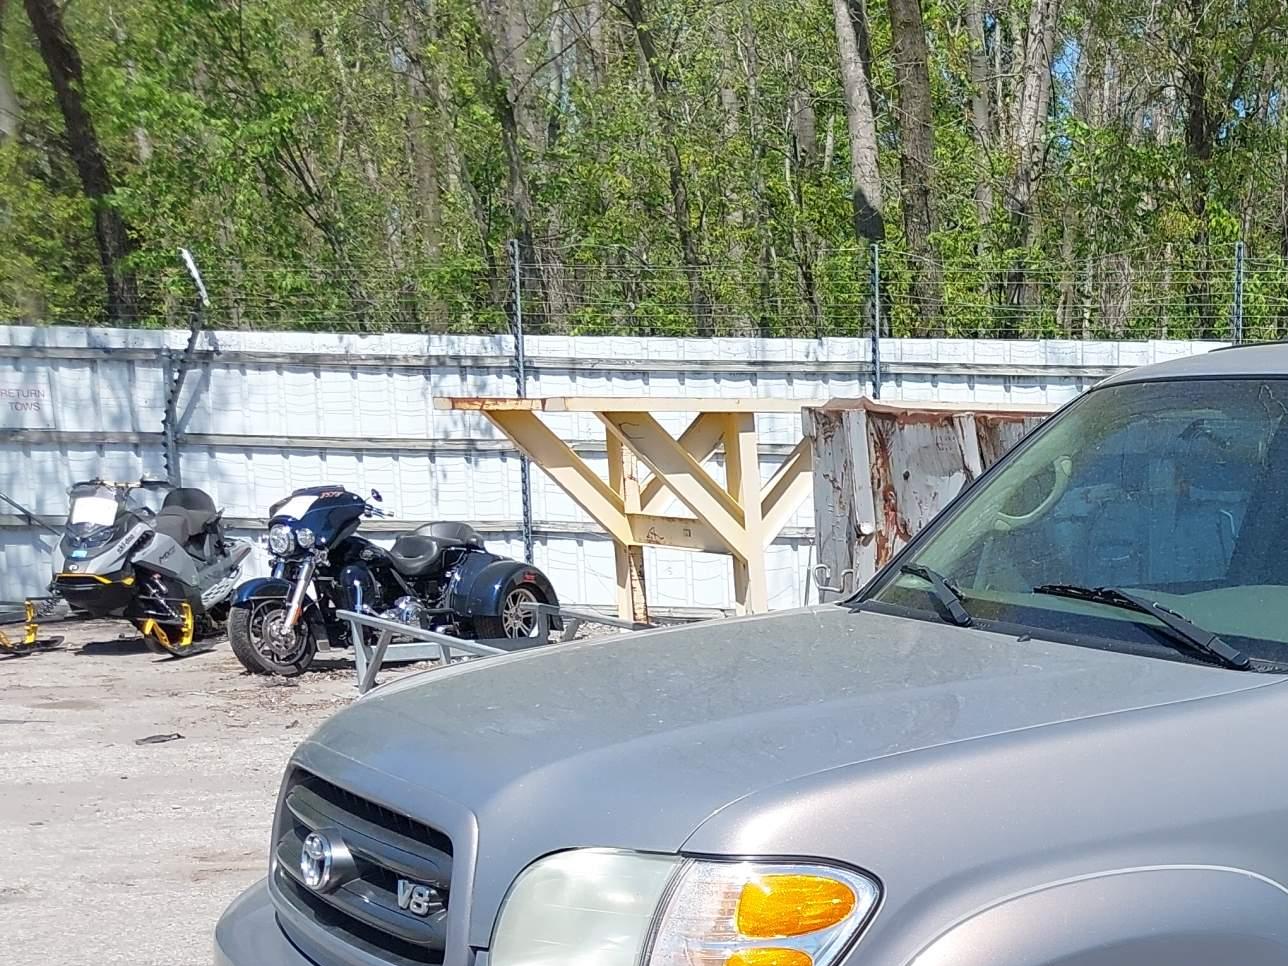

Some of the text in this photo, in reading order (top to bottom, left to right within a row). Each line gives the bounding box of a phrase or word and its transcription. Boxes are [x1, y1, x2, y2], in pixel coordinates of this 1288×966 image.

[0, 389, 45, 398] RETURN
[8, 401, 41, 411] TOWS
[397, 879, 431, 916] V8
